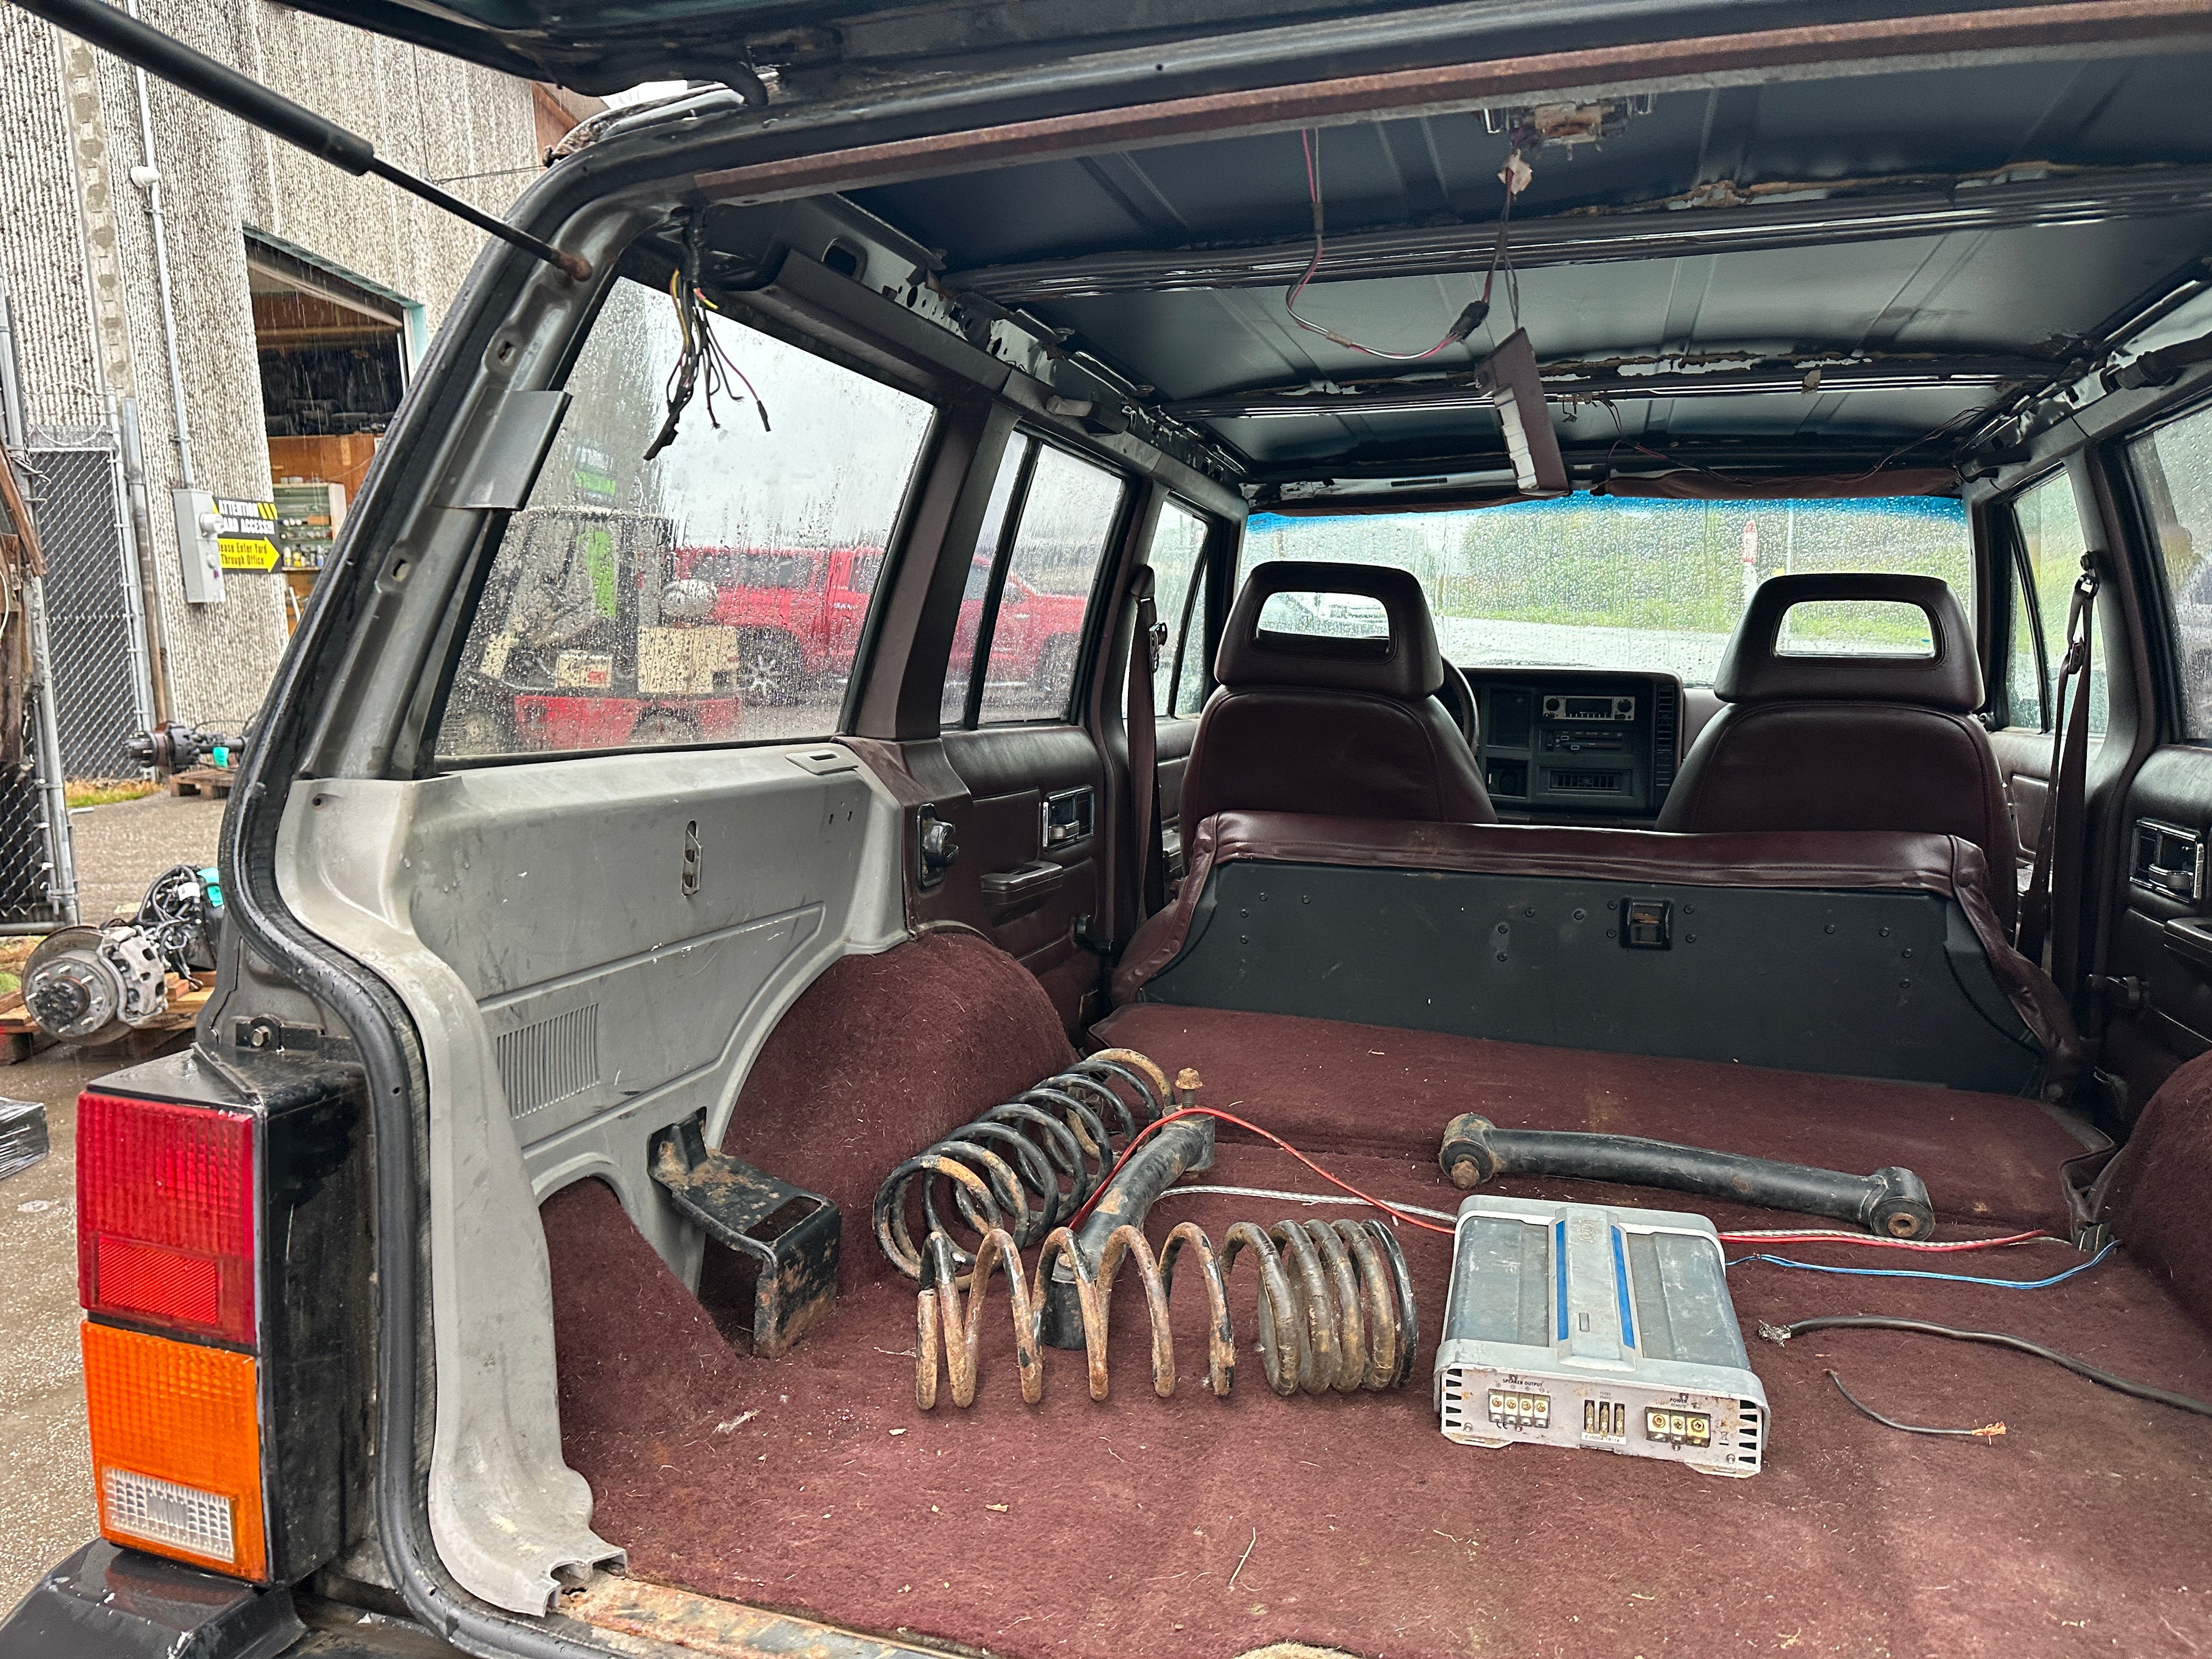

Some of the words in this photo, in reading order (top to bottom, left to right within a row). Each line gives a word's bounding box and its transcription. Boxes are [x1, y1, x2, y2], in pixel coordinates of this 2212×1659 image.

[219, 499, 259, 517] ATTENTION
[222, 517, 239, 532] ARD
[236, 543, 252, 554] Enter
[254, 544, 267, 554] Yard
[221, 554, 245, 566] Through
[247, 554, 264, 565] Office
